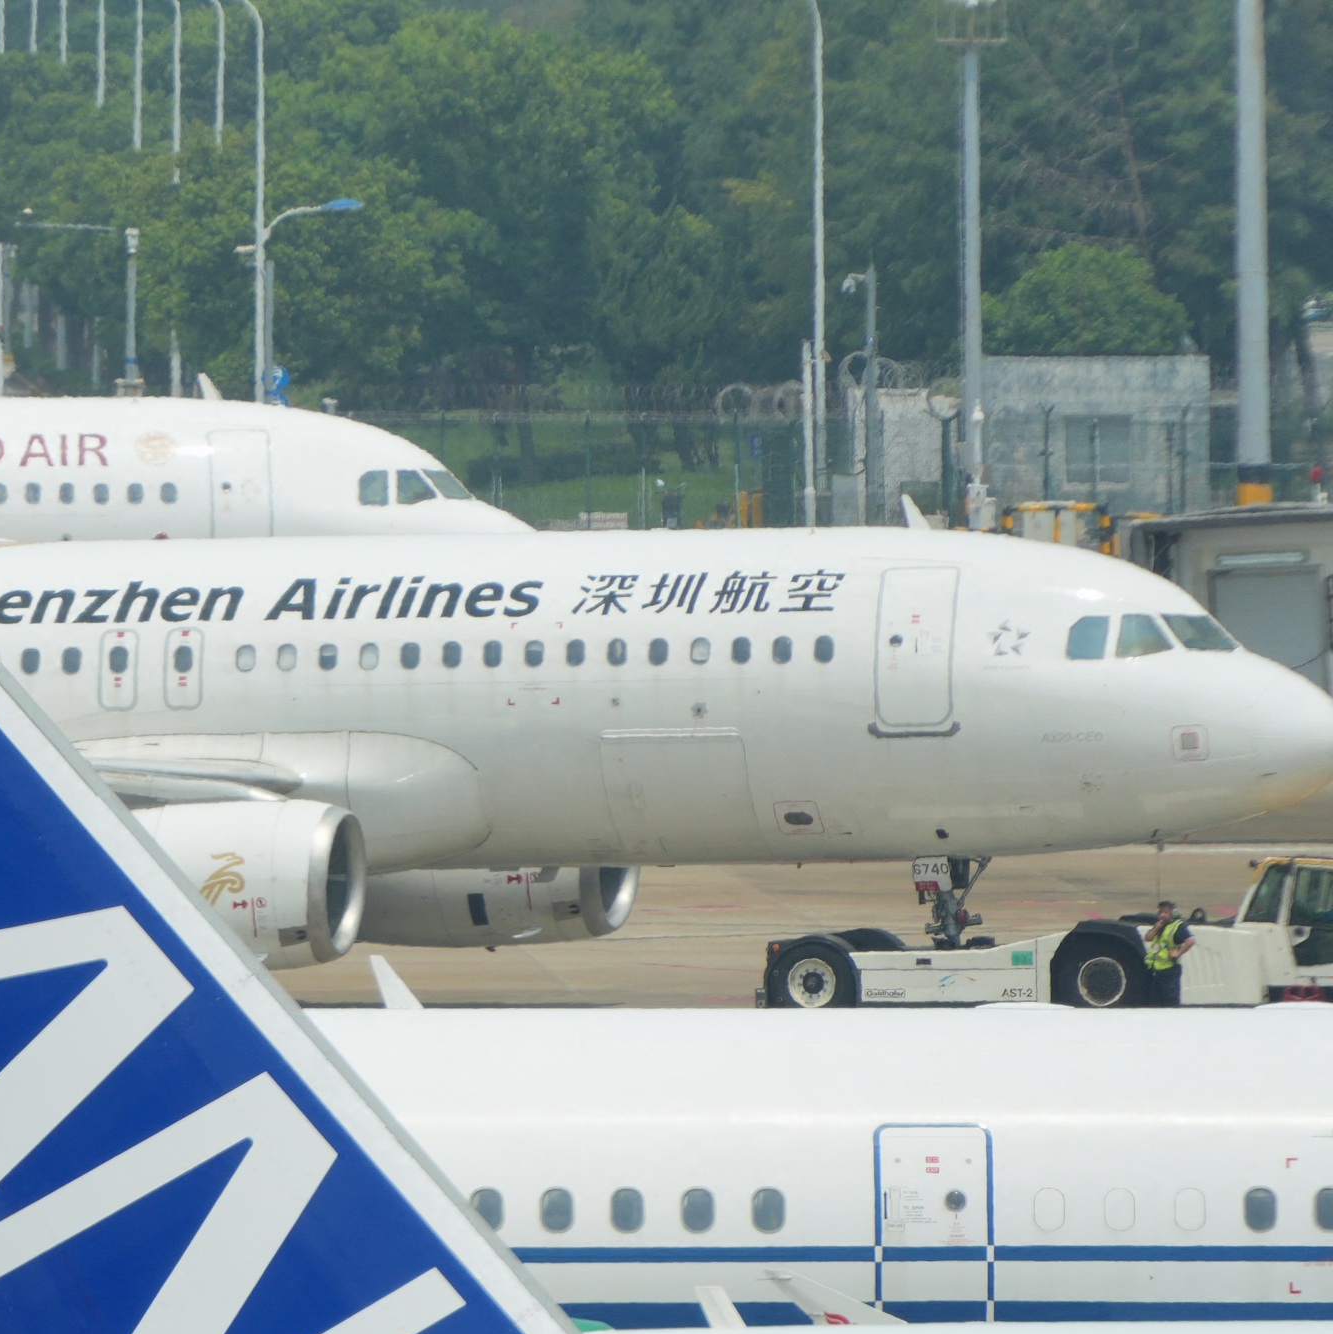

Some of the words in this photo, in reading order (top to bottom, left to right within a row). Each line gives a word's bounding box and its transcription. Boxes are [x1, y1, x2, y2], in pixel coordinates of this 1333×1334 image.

[19, 433, 110, 468] AIR
[264, 574, 544, 621] Airlines
[571, 568, 846, 616] 深圳航空
[913, 862, 950, 876] 6740
[1002, 987, 1034, 999] AST-2
